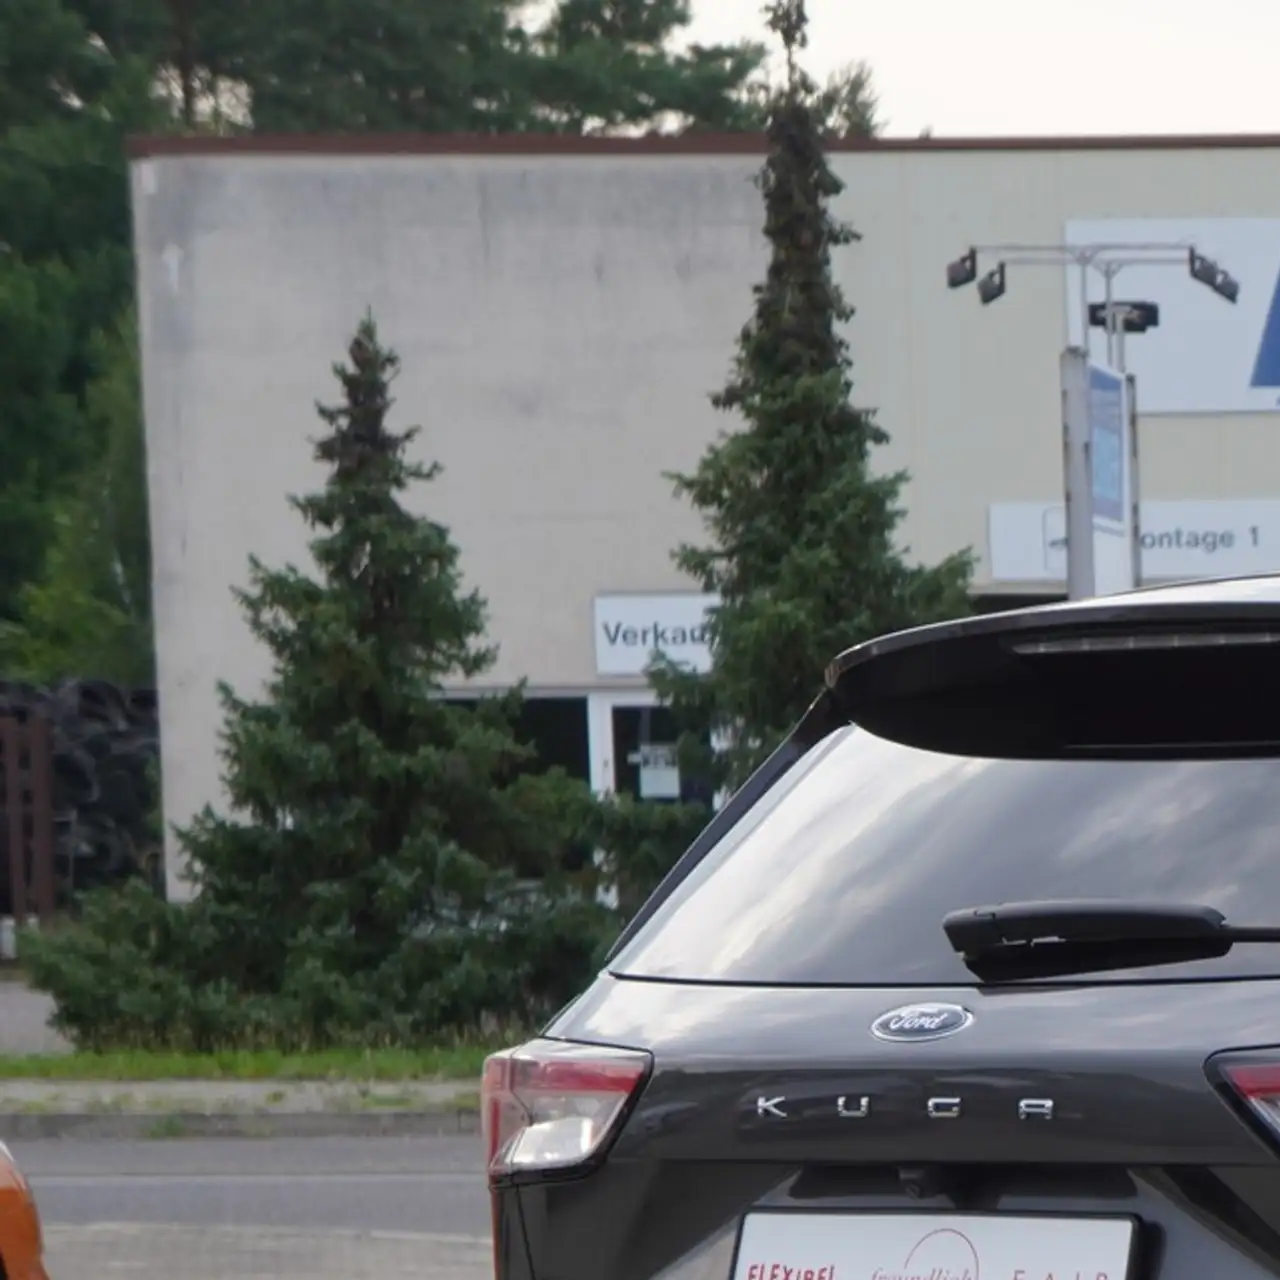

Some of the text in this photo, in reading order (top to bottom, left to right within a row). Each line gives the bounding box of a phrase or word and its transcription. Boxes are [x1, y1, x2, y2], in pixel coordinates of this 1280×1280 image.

[1140, 525, 1260, 554] ontage 1
[602, 620, 711, 647] Verkau
[756, 1095, 1054, 1121] KUGA
